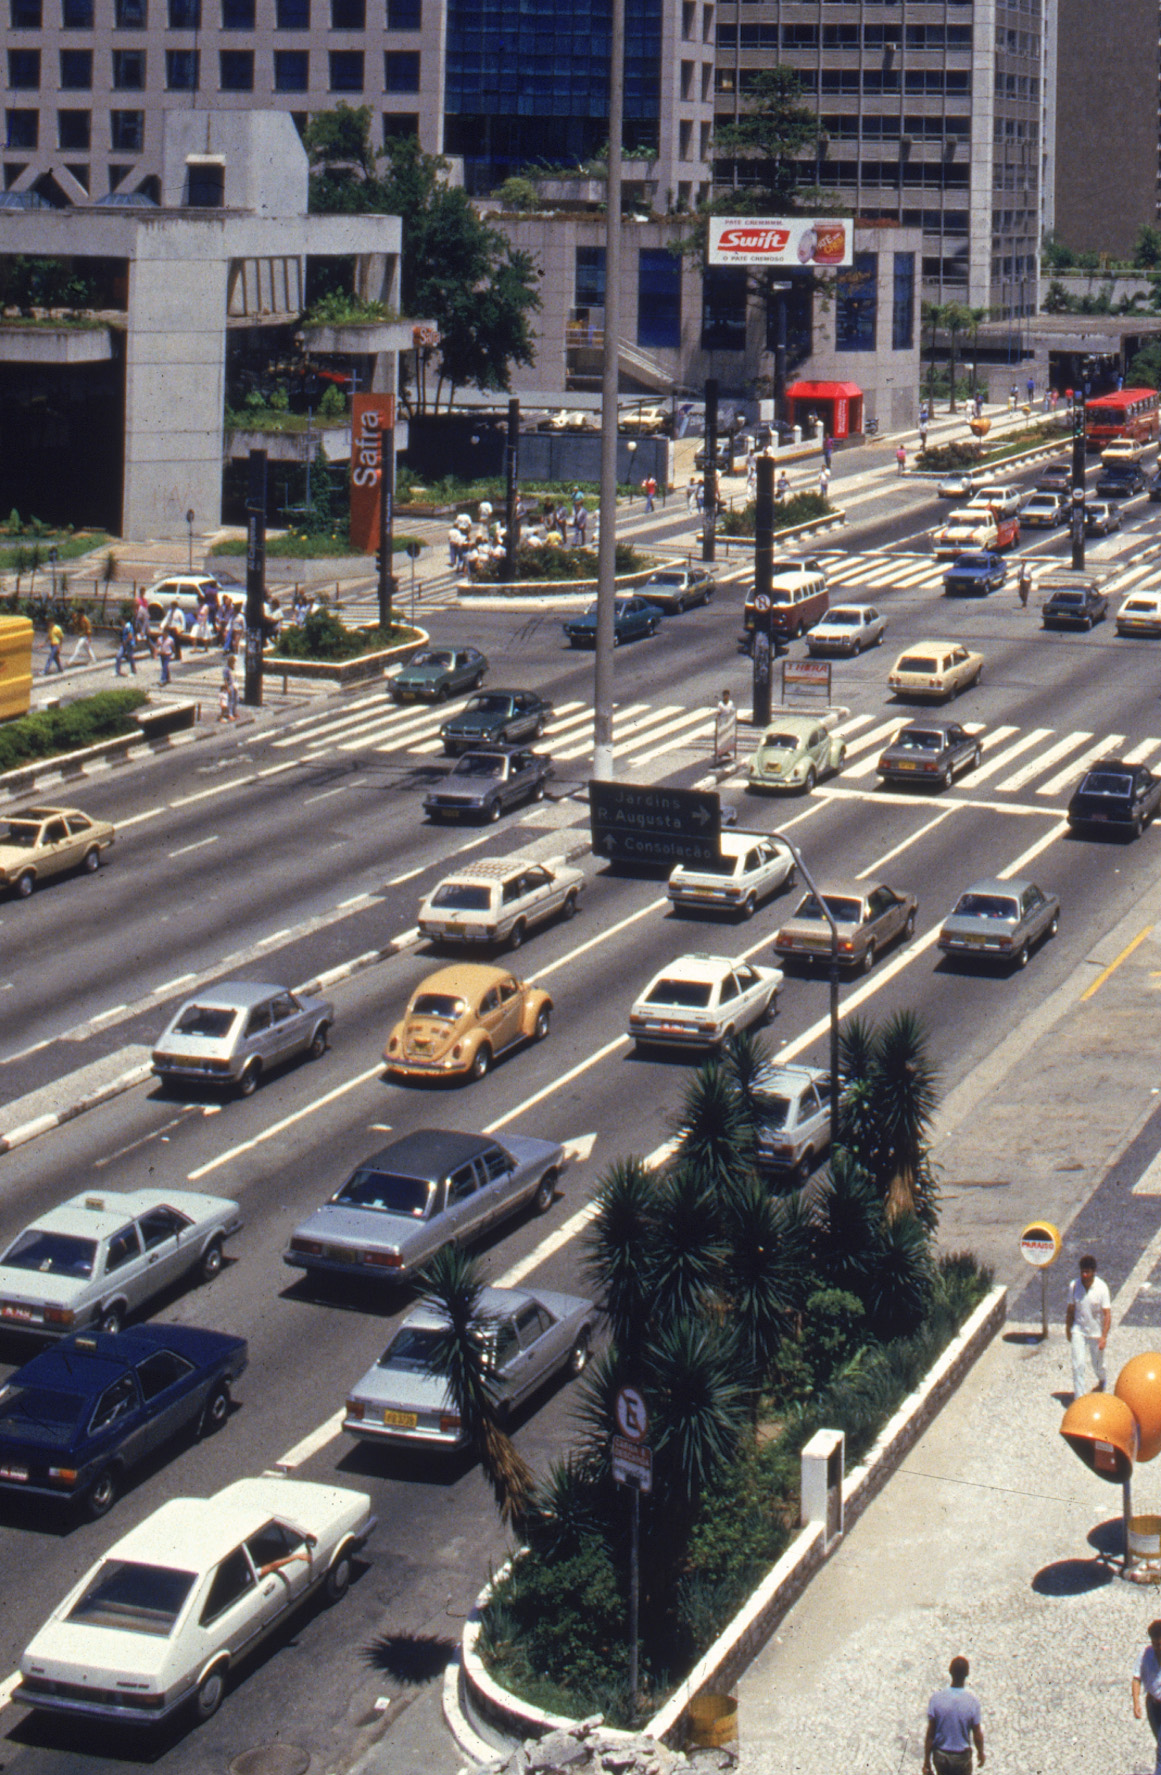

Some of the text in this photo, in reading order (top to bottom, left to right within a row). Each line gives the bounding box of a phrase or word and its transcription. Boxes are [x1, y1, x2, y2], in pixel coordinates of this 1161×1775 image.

[719, 230, 785, 249] Swift
[353, 410, 379, 487] Safra
[615, 791, 681, 809] Jardins
[598, 807, 682, 829] R. Augusta
